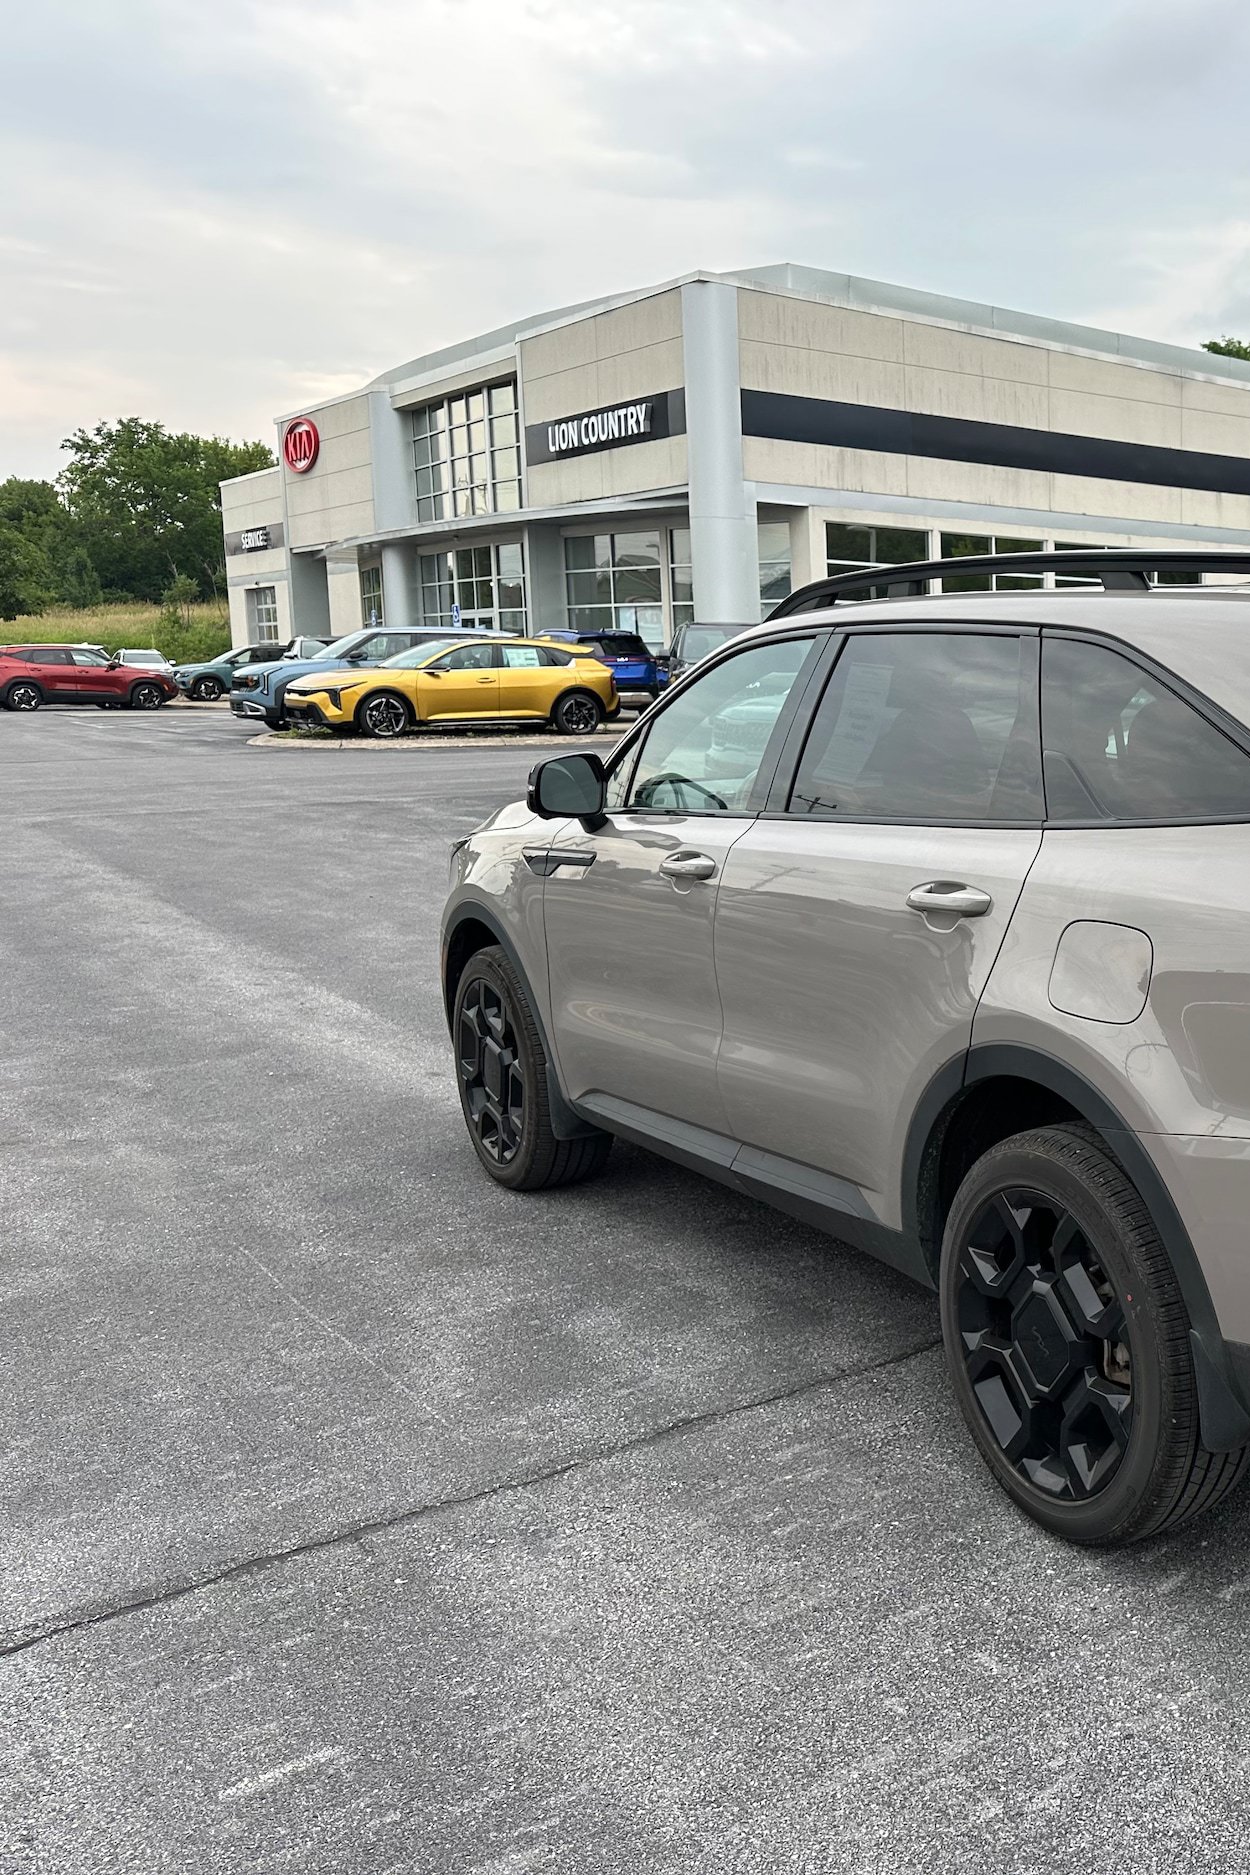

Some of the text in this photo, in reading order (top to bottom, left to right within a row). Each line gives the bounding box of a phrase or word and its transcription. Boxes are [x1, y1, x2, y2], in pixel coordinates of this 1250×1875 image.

[286, 430, 311, 462] KIA
[547, 402, 650, 453] LION COUNTRY
